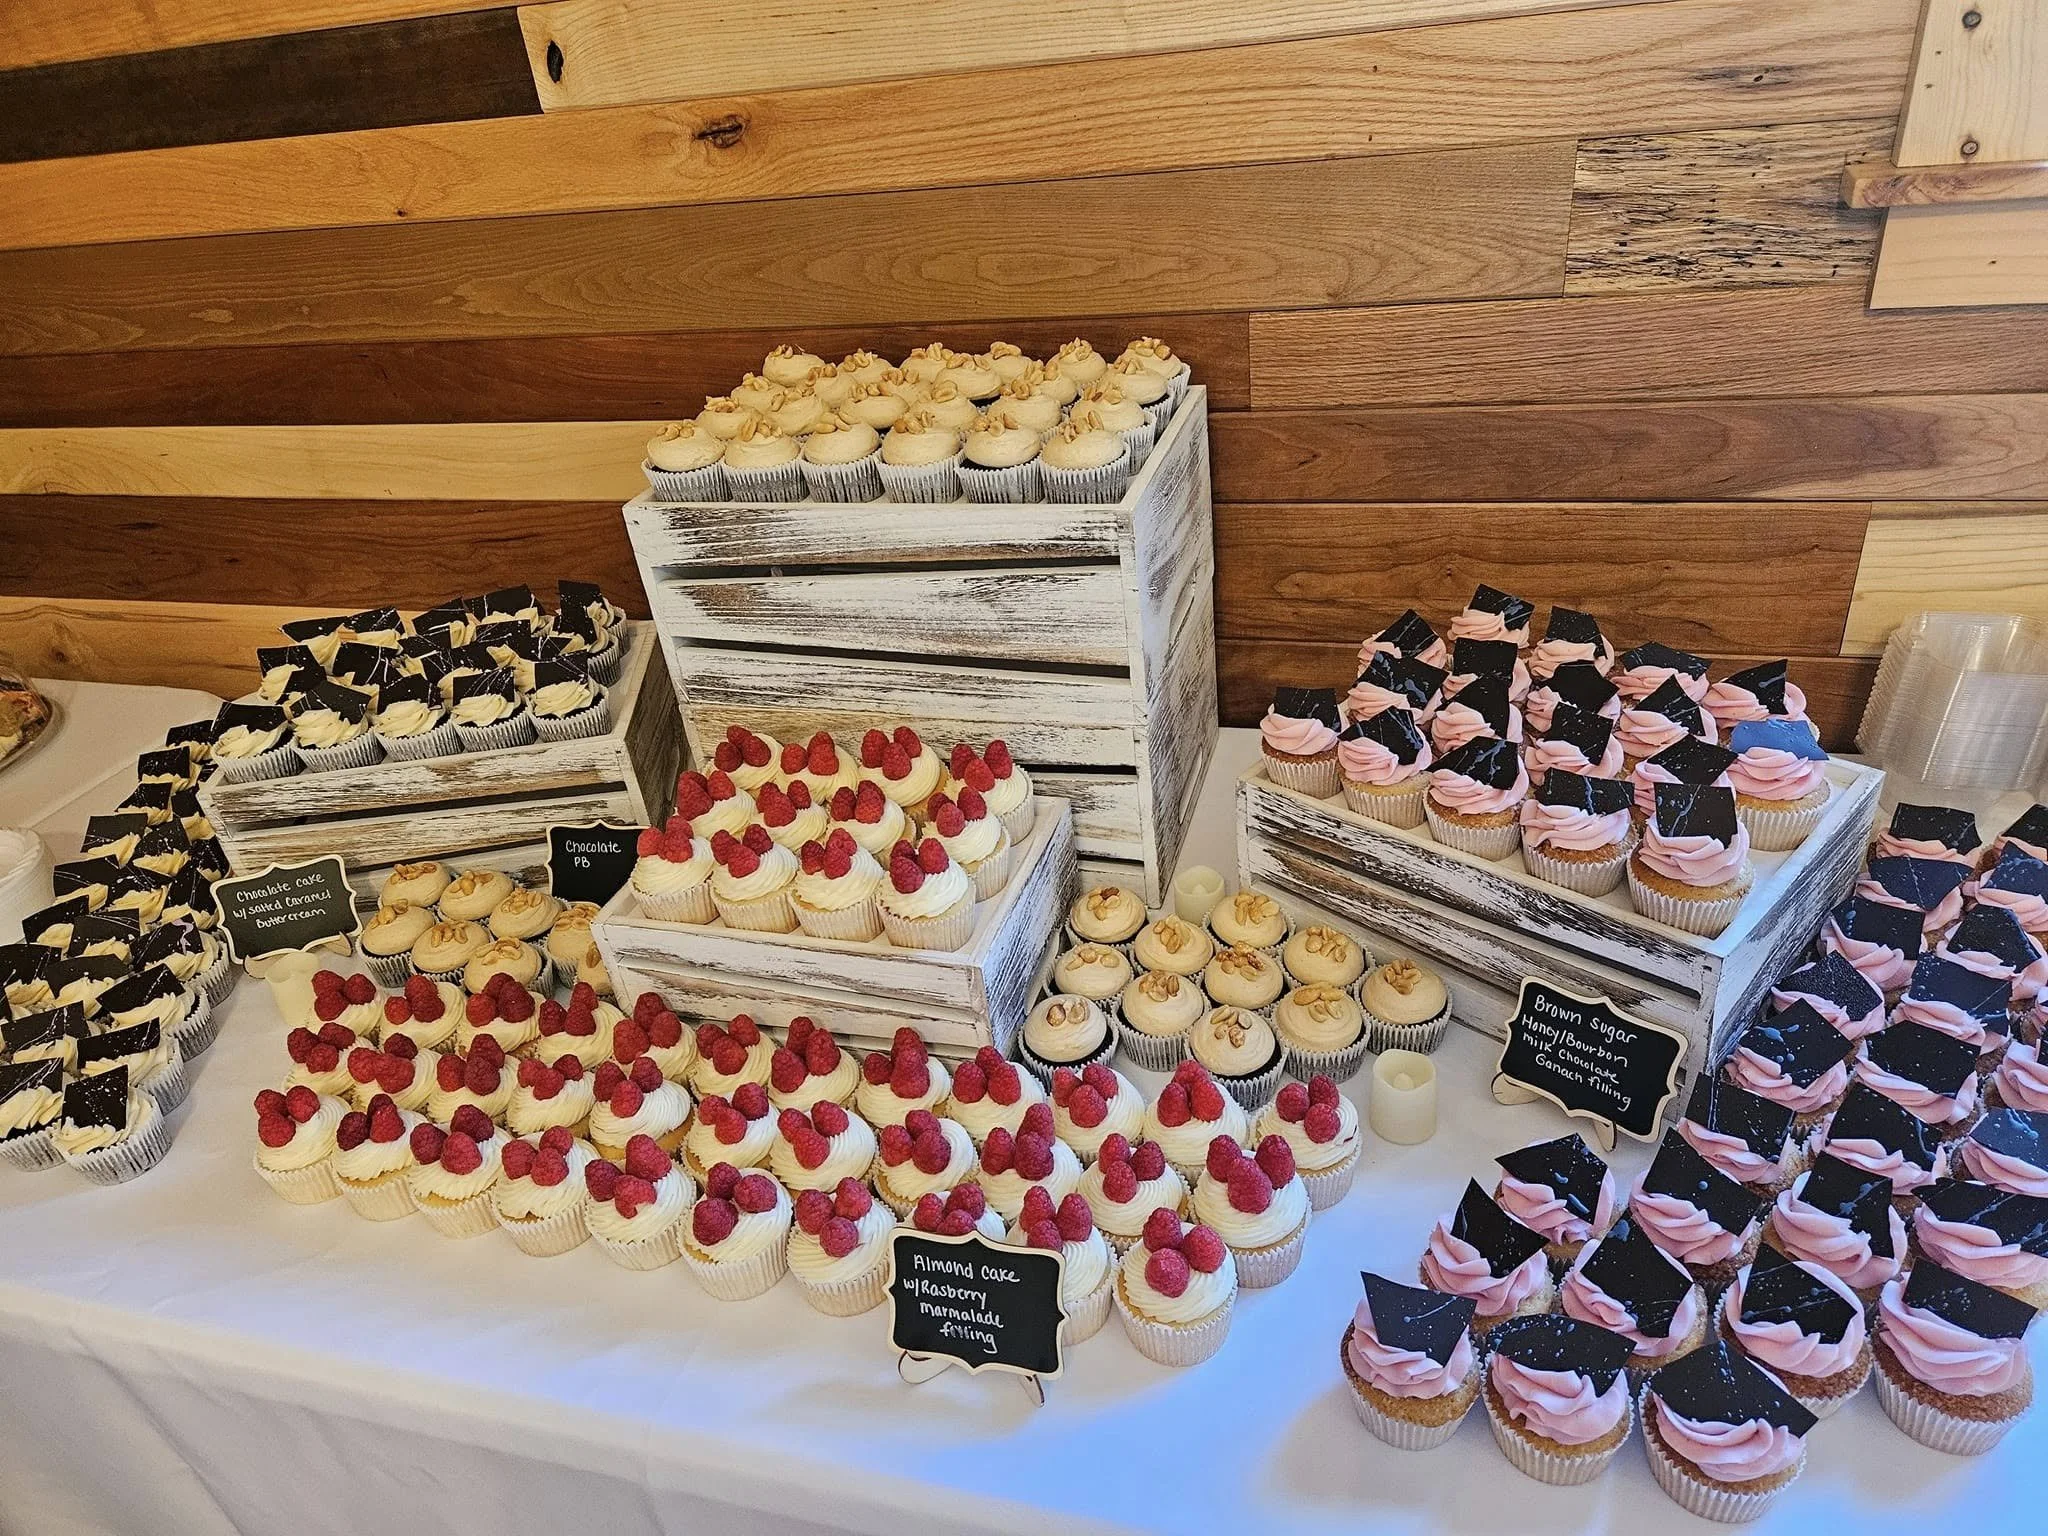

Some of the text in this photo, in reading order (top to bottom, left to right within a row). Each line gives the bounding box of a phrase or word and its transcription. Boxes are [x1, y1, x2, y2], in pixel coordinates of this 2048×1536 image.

[565, 839, 622, 853] Chocolate
[574, 856, 591, 868] PB
[236, 881, 291, 903] Chocolate
[1534, 994, 1582, 1026] Brown
[1535, 1053, 1584, 1084] Ganach
[913, 1254, 974, 1280] Almond
[919, 1301, 1004, 1329] marmalade
